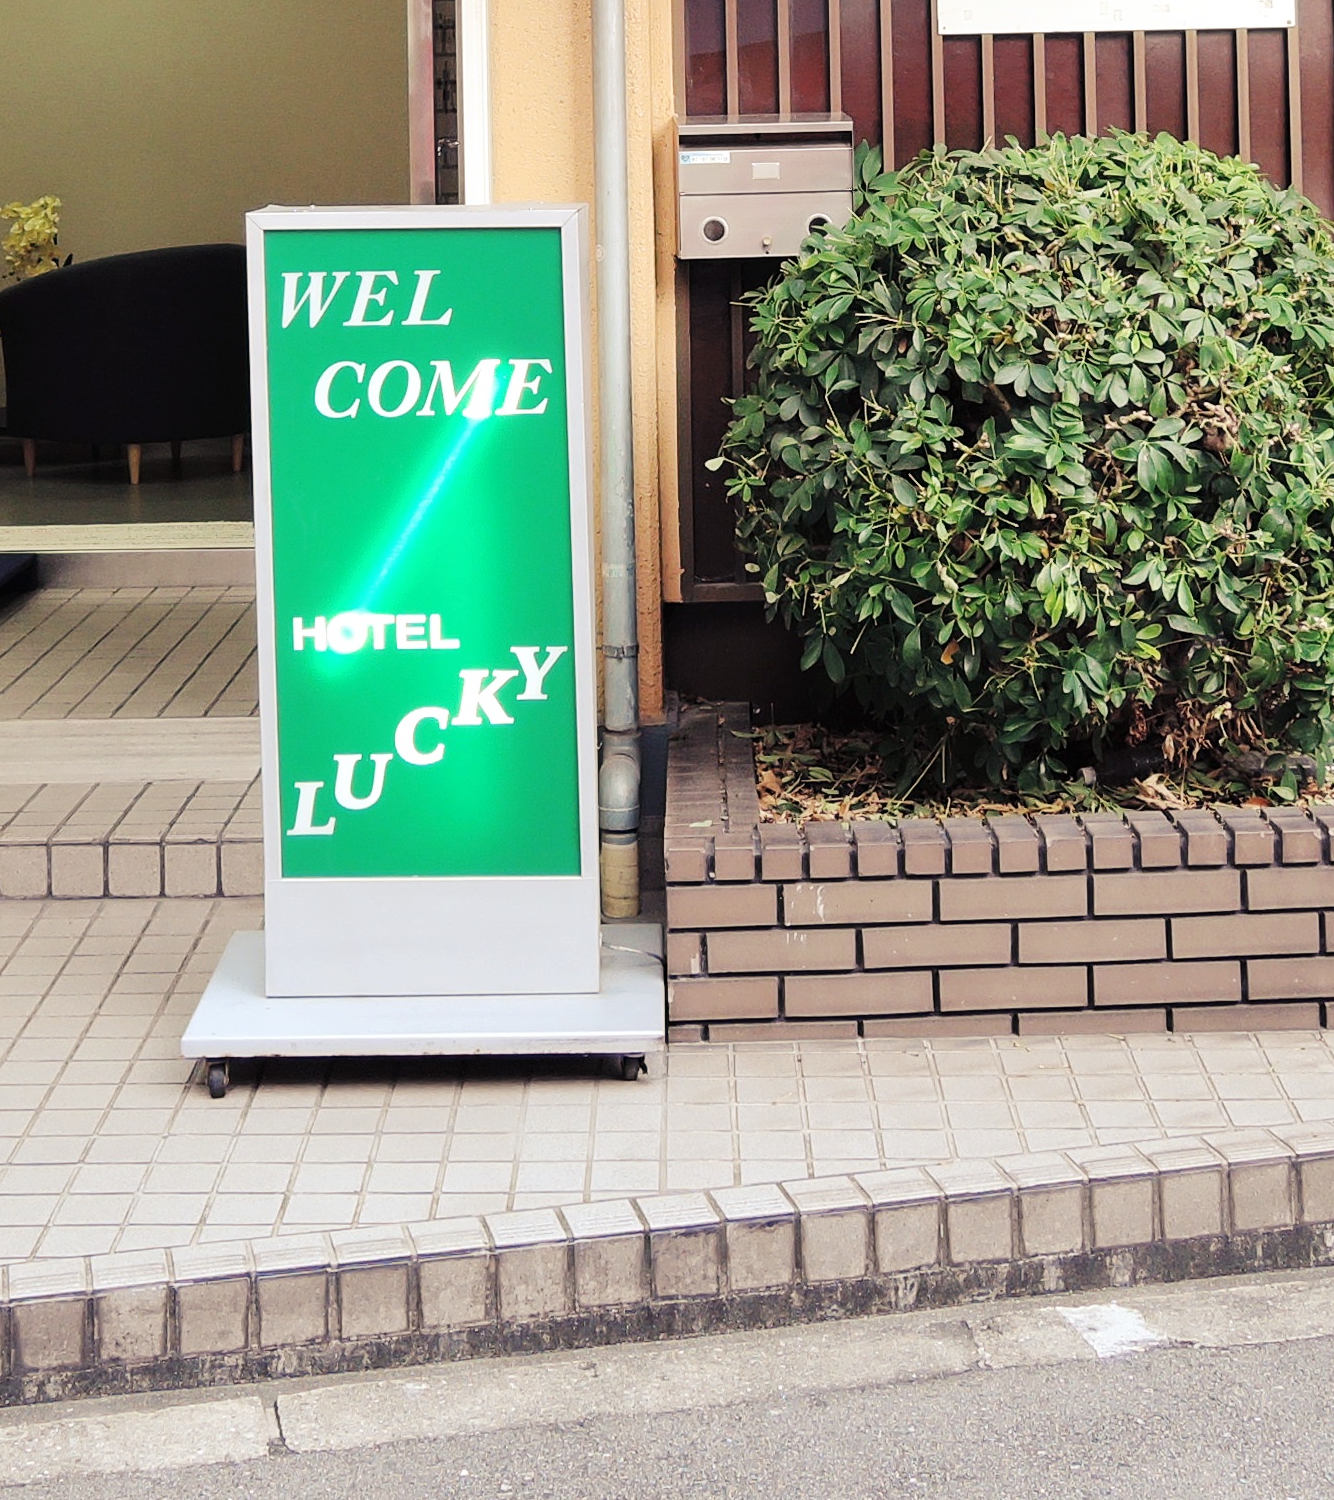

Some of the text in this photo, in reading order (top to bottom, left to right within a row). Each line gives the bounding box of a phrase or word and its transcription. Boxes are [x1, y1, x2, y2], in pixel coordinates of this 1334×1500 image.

[281, 270, 453, 329] WEL
[314, 358, 553, 419] COME
[292, 612, 461, 654] HOTEL
[286, 645, 568, 836] LUCKY
